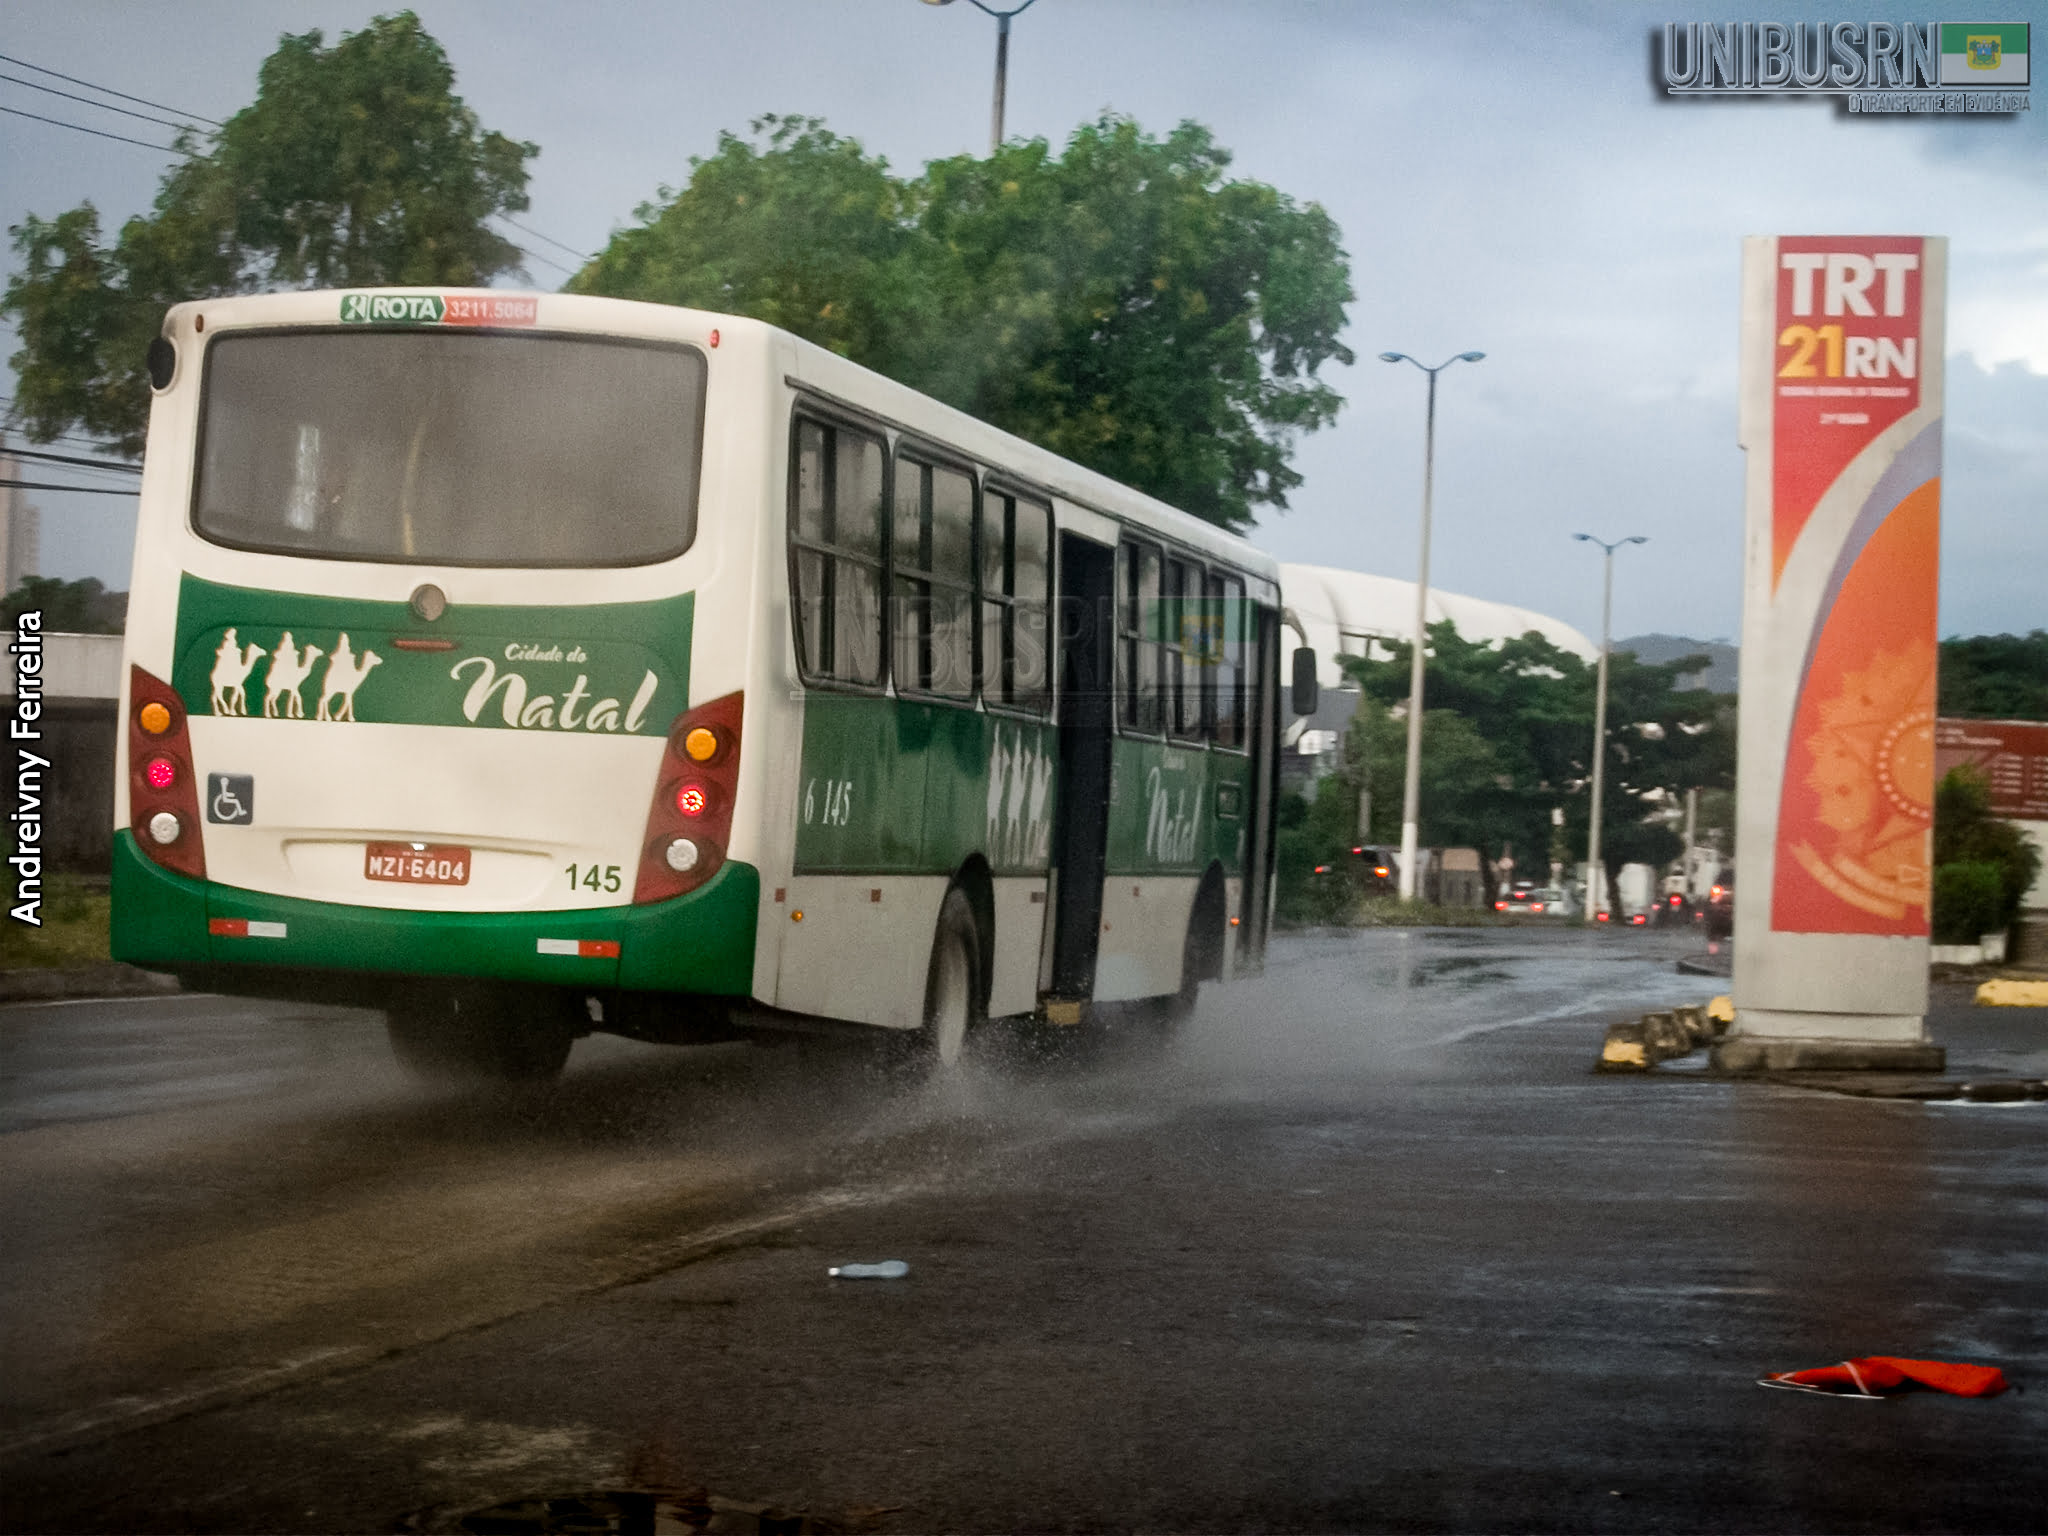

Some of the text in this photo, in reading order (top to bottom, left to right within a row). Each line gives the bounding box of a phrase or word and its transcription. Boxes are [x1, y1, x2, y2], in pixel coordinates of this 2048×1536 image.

[1781, 253, 1919, 317] TRT
[373, 297, 438, 319] ROTA
[504, 642, 588, 663] Cidade do
[450, 656, 659, 732] Natal
[804, 778, 852, 826] 6 145
[564, 863, 622, 893] 145
